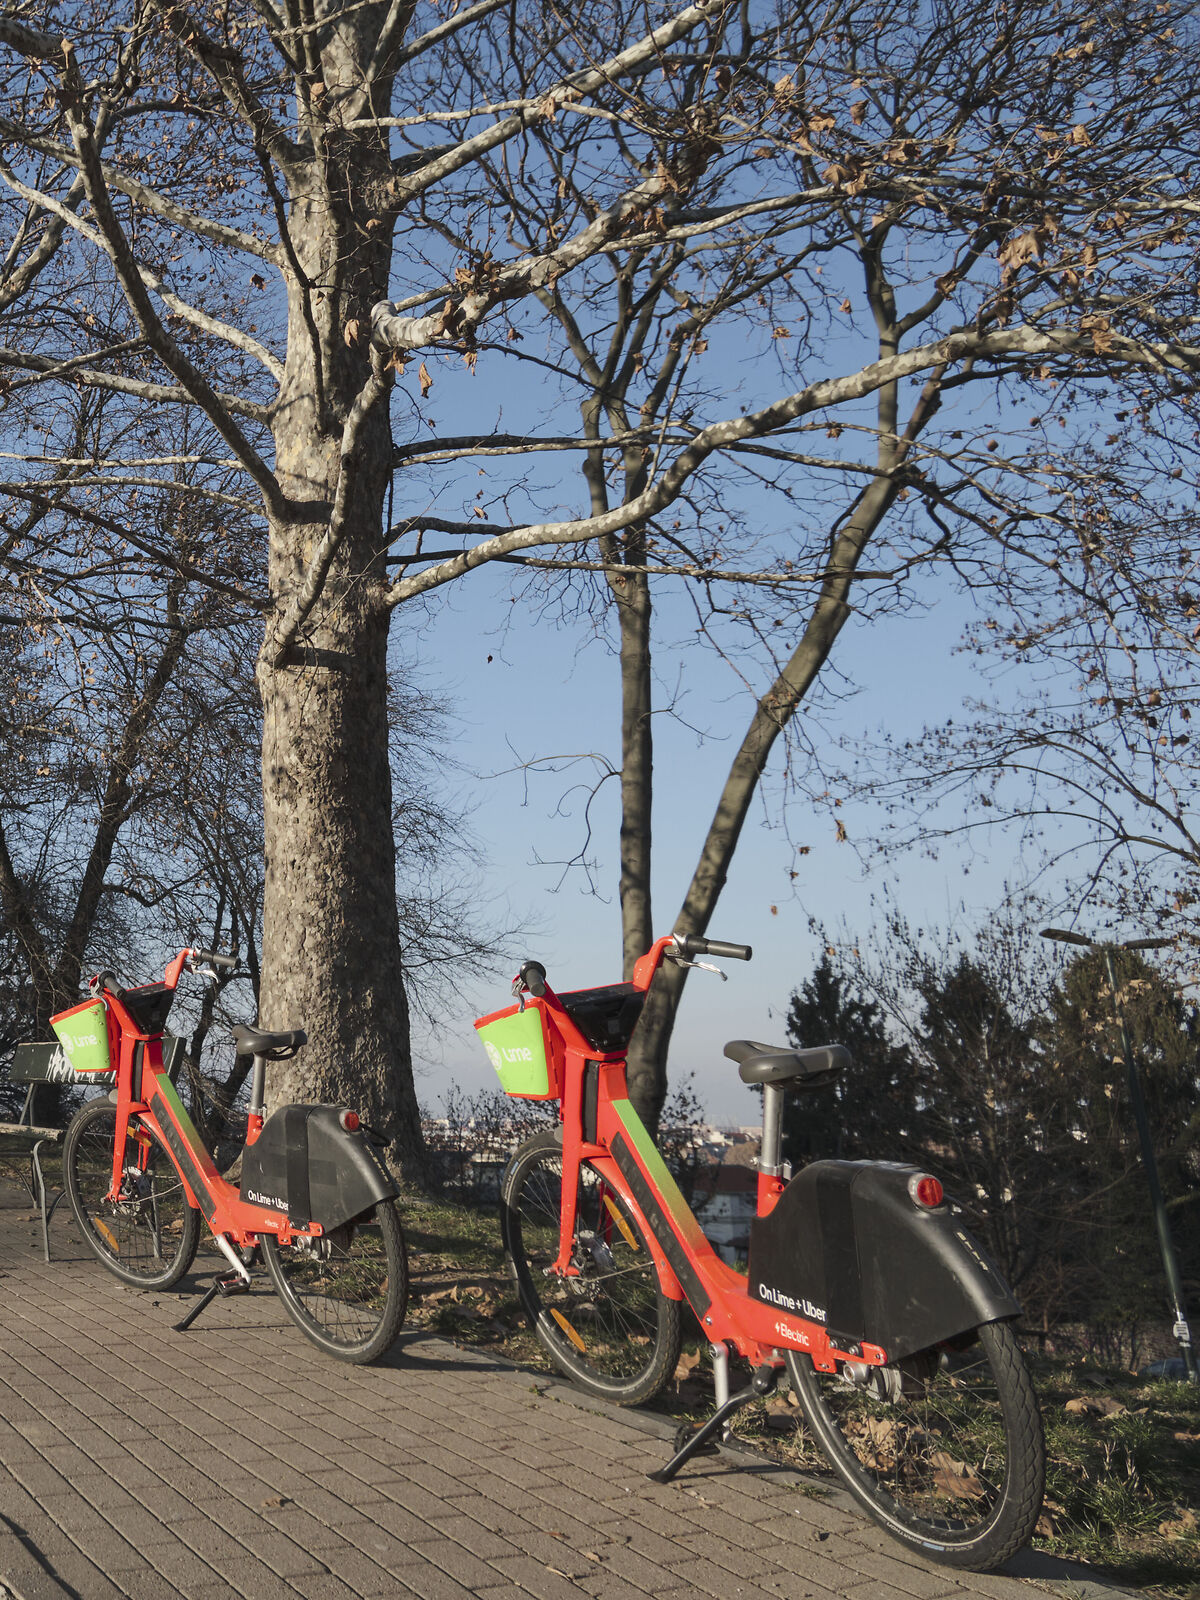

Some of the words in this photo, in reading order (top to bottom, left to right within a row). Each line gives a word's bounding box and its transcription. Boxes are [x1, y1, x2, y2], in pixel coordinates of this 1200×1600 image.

[502, 1047, 532, 1063] Lime
[248, 1190, 256, 1201] On
[257, 1192, 271, 1205] Lime
[759, 1283, 772, 1301] On
[772, 1288, 795, 1309] Lime
[795, 1299, 802, 1309] +
[802, 1299, 826, 1322] Uber
[780, 1322, 809, 1346] Electric
